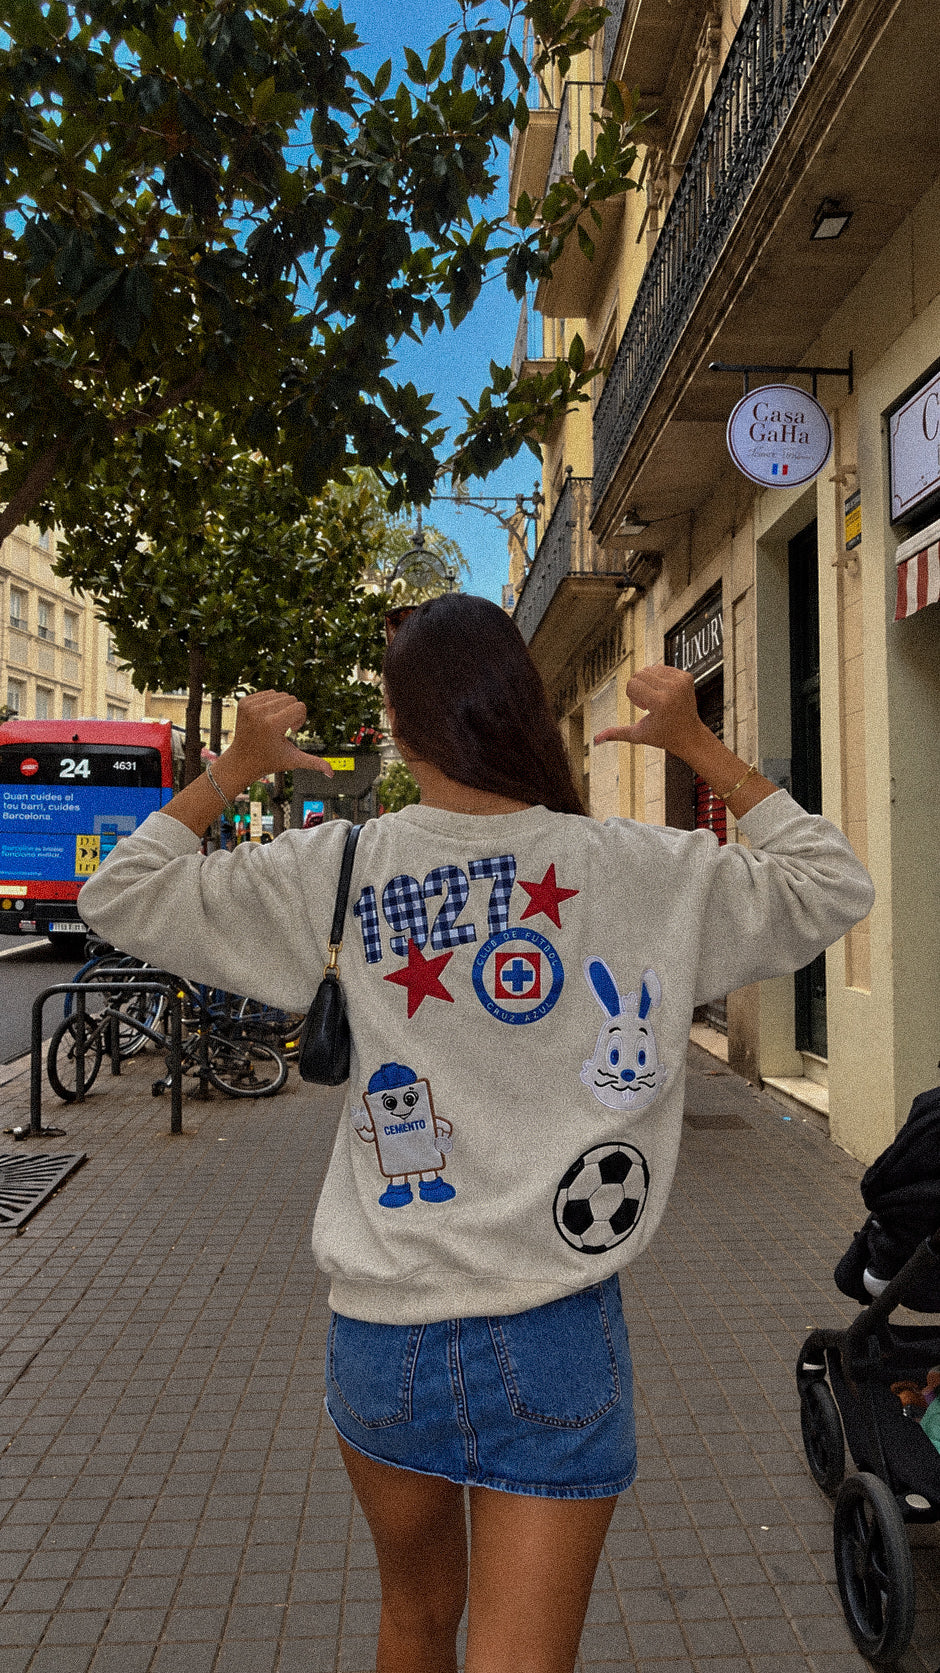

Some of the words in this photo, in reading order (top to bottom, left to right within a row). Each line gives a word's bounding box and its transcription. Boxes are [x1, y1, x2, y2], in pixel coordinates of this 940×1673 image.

[752, 401, 806, 424] Casa
[59, 758, 91, 779] 24
[112, 760, 137, 771] 4631
[30, 792, 62, 801] cuides
[65, 793, 74, 801] el
[3, 802, 19, 810] teu
[48, 802, 80, 811] cuides
[2, 812, 53, 821] Barcelona.
[353, 854, 517, 964] 1927
[476, 940, 498, 966] CLUB
[503, 930, 518, 941] DE
[525, 931, 559, 966] FUTBOL
[486, 1002, 515, 1022] CRUZ
[524, 1001, 553, 1022] AZUL
[383, 1119, 427, 1136] CEMENTO
